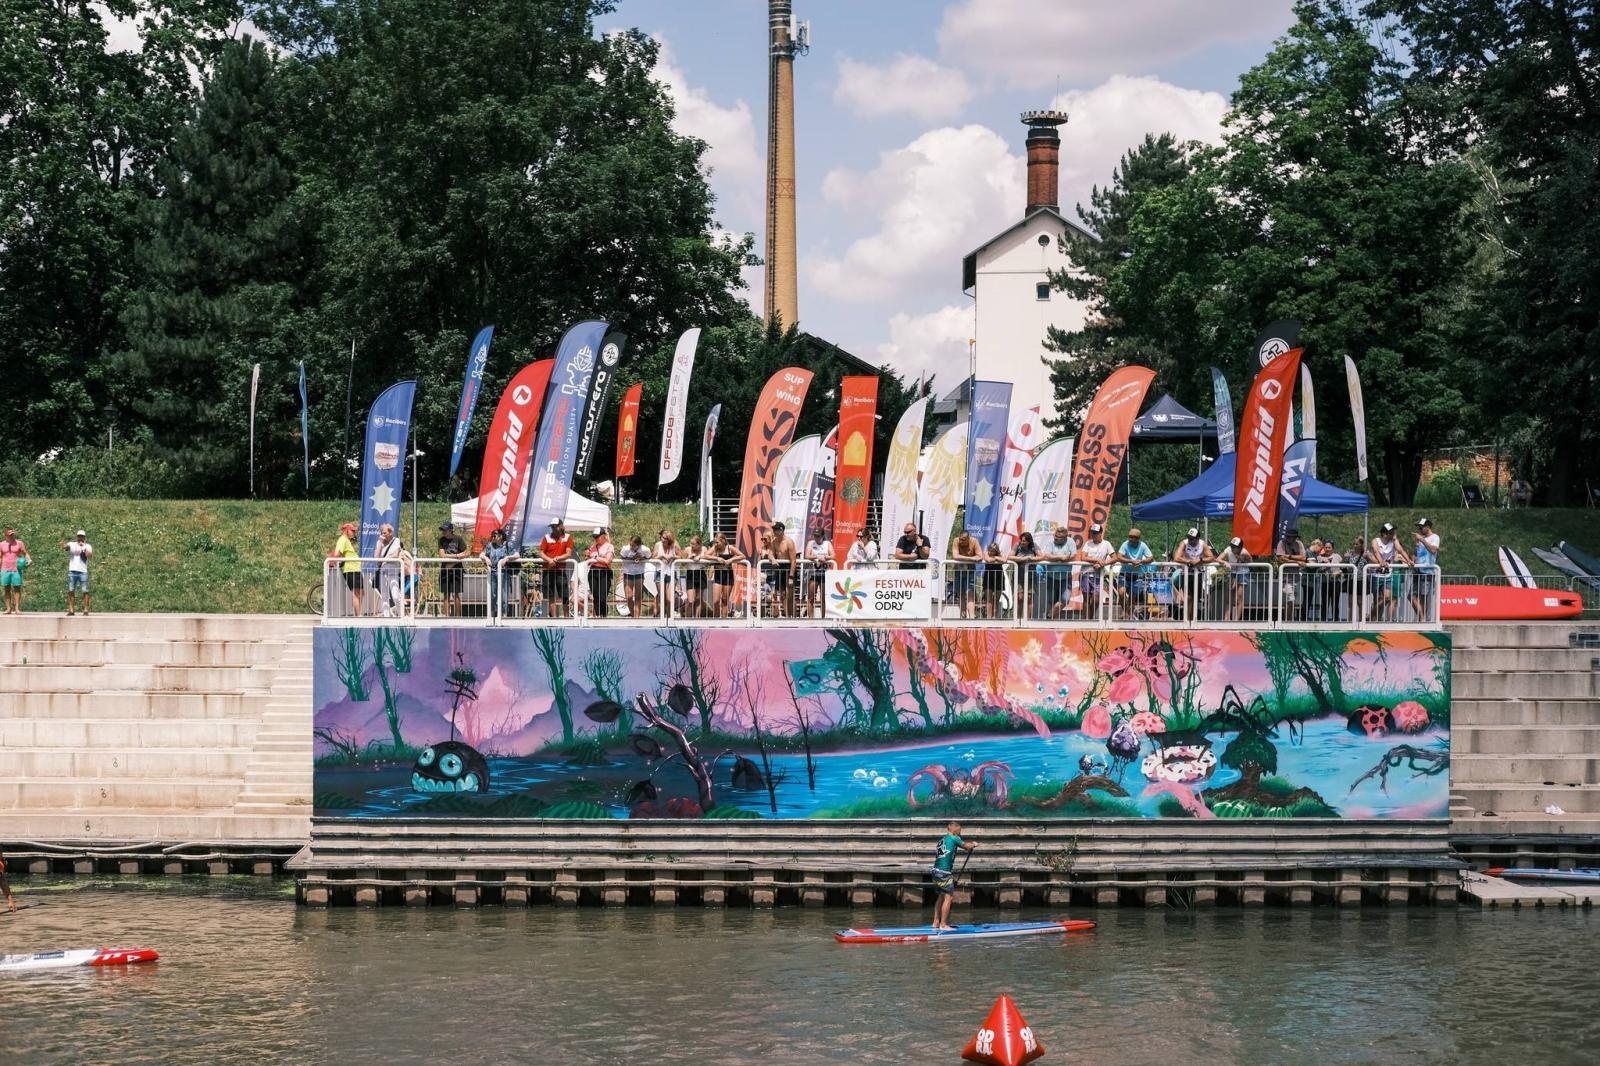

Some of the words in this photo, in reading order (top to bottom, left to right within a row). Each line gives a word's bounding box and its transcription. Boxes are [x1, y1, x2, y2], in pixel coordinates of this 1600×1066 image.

[783, 373, 804, 385] SUP
[776, 389, 801, 405] WING
[566, 407, 577, 443] QUALITY
[1075, 422, 1107, 491] BASS
[790, 489, 808, 497] PCS
[812, 487, 825, 501] 21
[1042, 491, 1057, 500] PCS
[1090, 443, 1125, 535] OLSKA
[810, 500, 822, 514] 23
[808, 513, 833, 532] 202
[875, 579, 926, 589] FESTIWAL
[874, 601, 905, 611] ODRY
